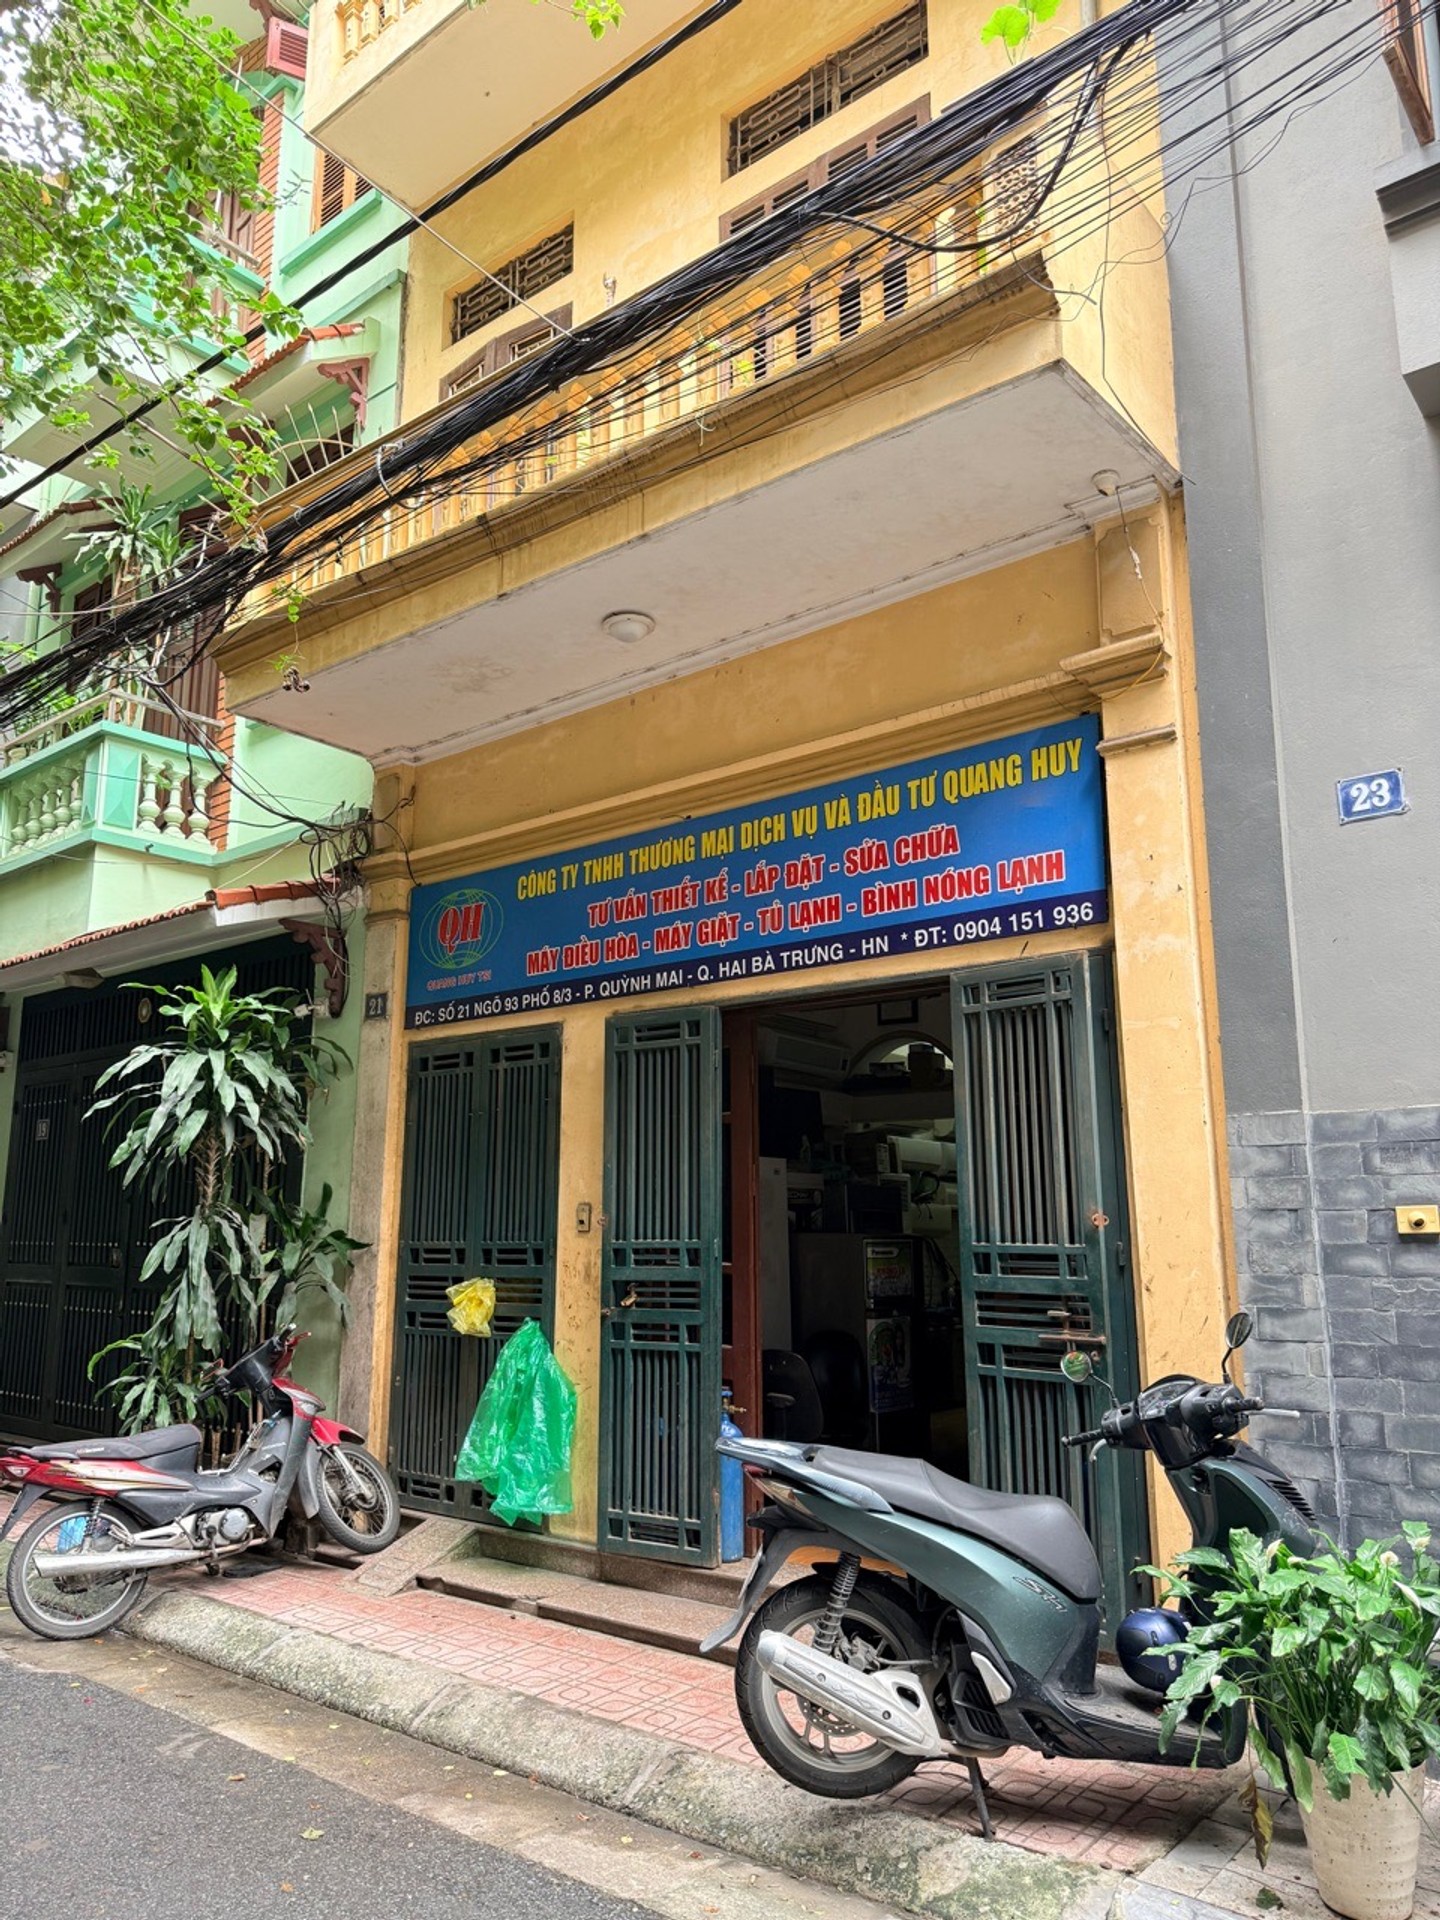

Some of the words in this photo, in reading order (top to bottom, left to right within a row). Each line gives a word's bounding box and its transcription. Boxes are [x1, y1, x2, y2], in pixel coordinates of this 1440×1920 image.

[517, 869, 557, 900] CÔNG
[561, 863, 579, 890] TY
[584, 852, 624, 886] TNHH
[629, 834, 695, 875] THƯƠNG
[701, 825, 735, 860] MẠI
[741, 813, 786, 851] DỊCH
[792, 805, 818, 839] VỤ
[824, 794, 851, 830] VÀ
[857, 780, 900, 823] ĐẦU
[908, 770, 937, 810] TƯ
[943, 754, 1023, 804] QUANG
[1031, 738, 1082, 781] HUY
[1350, 778, 1390, 812] 23
[438, 901, 487, 955] QH
[526, 946, 559, 976] MÁY
[563, 935, 600, 970] ĐIỀU
[604, 931, 639, 963] HÒA
[654, 920, 694, 955] MÁY
[697, 911, 741, 947] GIẶT
[757, 899, 784, 935] TỦ
[789, 893, 842, 932] LẠNH
[862, 880, 917, 917] BÌNH
[923, 864, 991, 906] NÓNG
[997, 850, 1066, 894] LẠNH
[587, 897, 611, 928] TƯ
[614, 888, 647, 923] VẤN
[652, 875, 700, 916] THIẾT
[704, 867, 729, 905] KẾ
[744, 860, 780, 897] LẮP
[784, 853, 826, 890] ĐẶT
[844, 838, 890, 877] SỬA
[894, 823, 961, 866] CHỮA
[369, 996, 384, 1015] 21
[415, 1010, 435, 1026] ĐC:
[438, 1001, 455, 1022] SỐ
[457, 1004, 470, 1019] 21
[474, 996, 502, 1017] NGÕ
[504, 996, 519, 1012] 93
[522, 985, 550, 1009] PHỐ
[553, 988, 572, 1004] 8/3
[584, 984, 596, 1000] P.
[600, 974, 651, 997] QUỲNH
[655, 969, 683, 988] MAI
[697, 965, 714, 981] Q.
[719, 958, 746, 978] HAI
[751, 951, 775, 973] BÀ
[780, 943, 844, 968] TRƯNG
[861, 935, 889, 956] HN
[914, 926, 947, 947] ĐT:
[953, 916, 1002, 941] 0904
[1008, 909, 1044, 932] 151
[1052, 902, 1094, 925] 936
